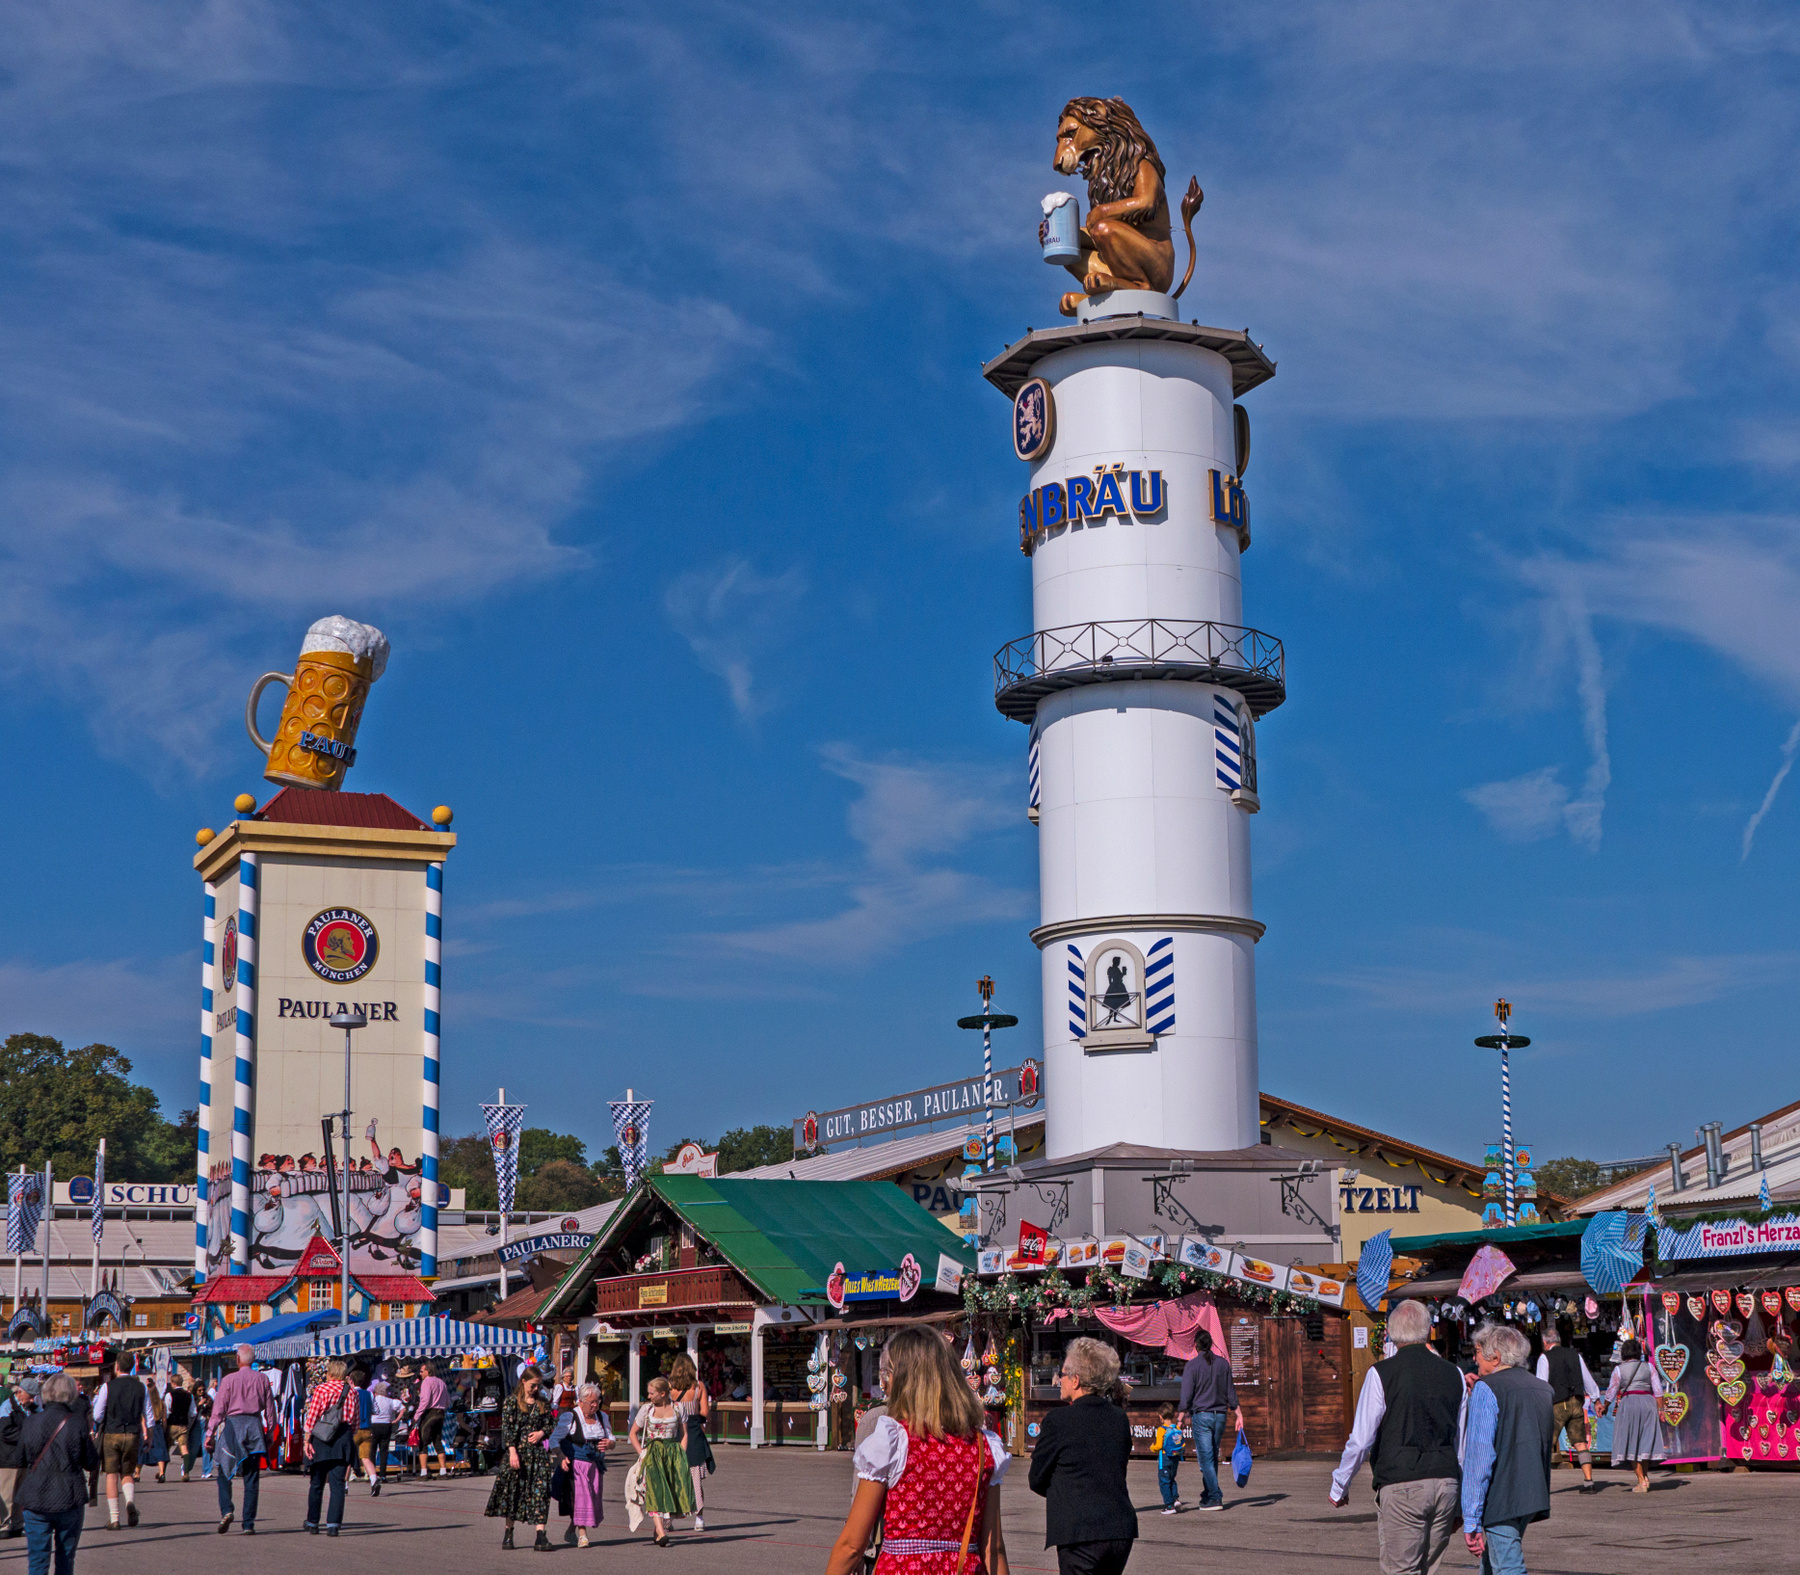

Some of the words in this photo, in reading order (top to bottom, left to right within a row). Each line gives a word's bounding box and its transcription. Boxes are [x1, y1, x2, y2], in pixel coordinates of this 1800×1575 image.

[307, 910, 374, 938] PAULANER
[312, 961, 368, 980] MÜNCHEN
[278, 998, 400, 1021] PAULANER
[826, 1115, 855, 1138] GUT,
[860, 1099, 918, 1131] BESSER,
[1340, 1185, 1422, 1211] TZELT
[1702, 1225, 1755, 1248] Franzl's
